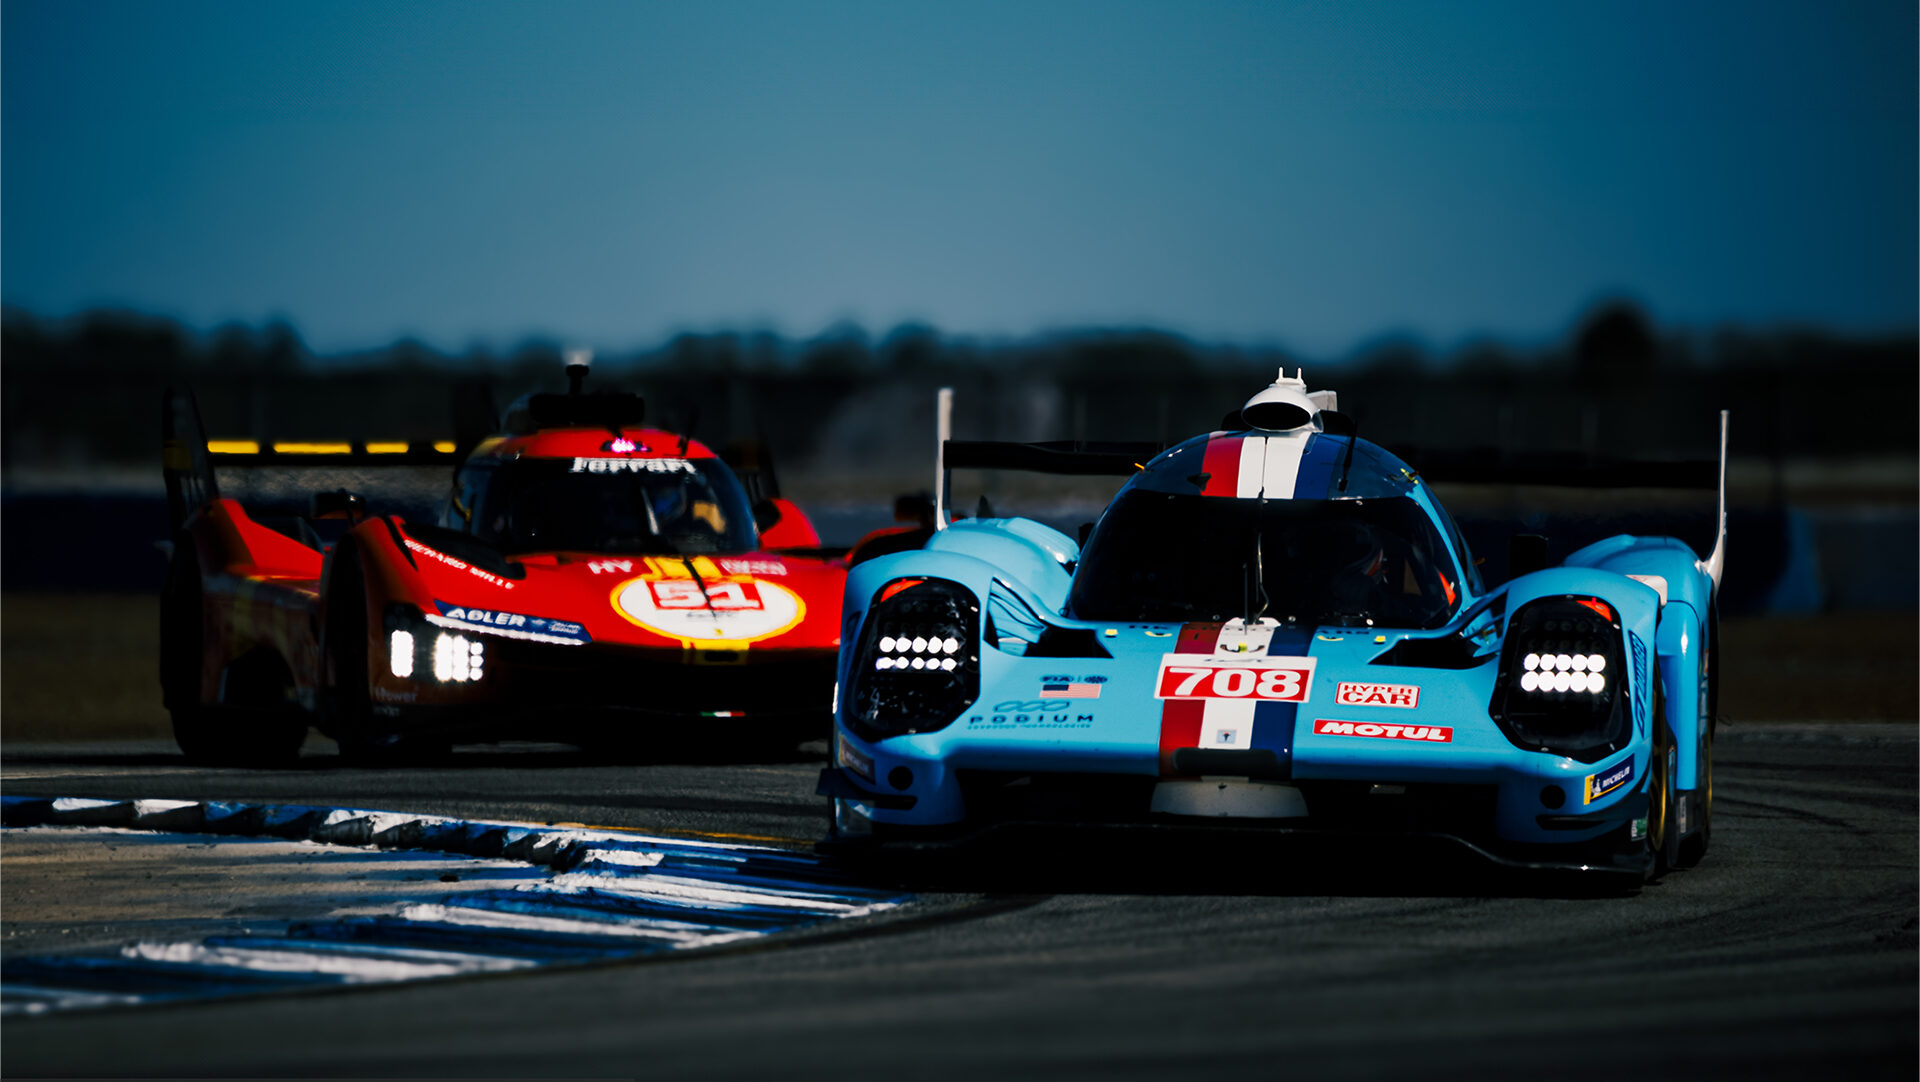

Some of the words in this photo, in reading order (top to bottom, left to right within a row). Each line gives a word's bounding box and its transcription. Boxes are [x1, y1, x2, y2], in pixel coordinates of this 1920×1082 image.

[568, 457, 696, 475] Ferrari
[652, 581, 760, 608] 51
[446, 608, 526, 627] ADLER
[1169, 667, 1301, 698] 708
[1344, 685, 1413, 695] HYPER
[1343, 692, 1411, 705] CAR
[969, 714, 1094, 724] PODIUM
[1320, 722, 1447, 741] MOTUL
